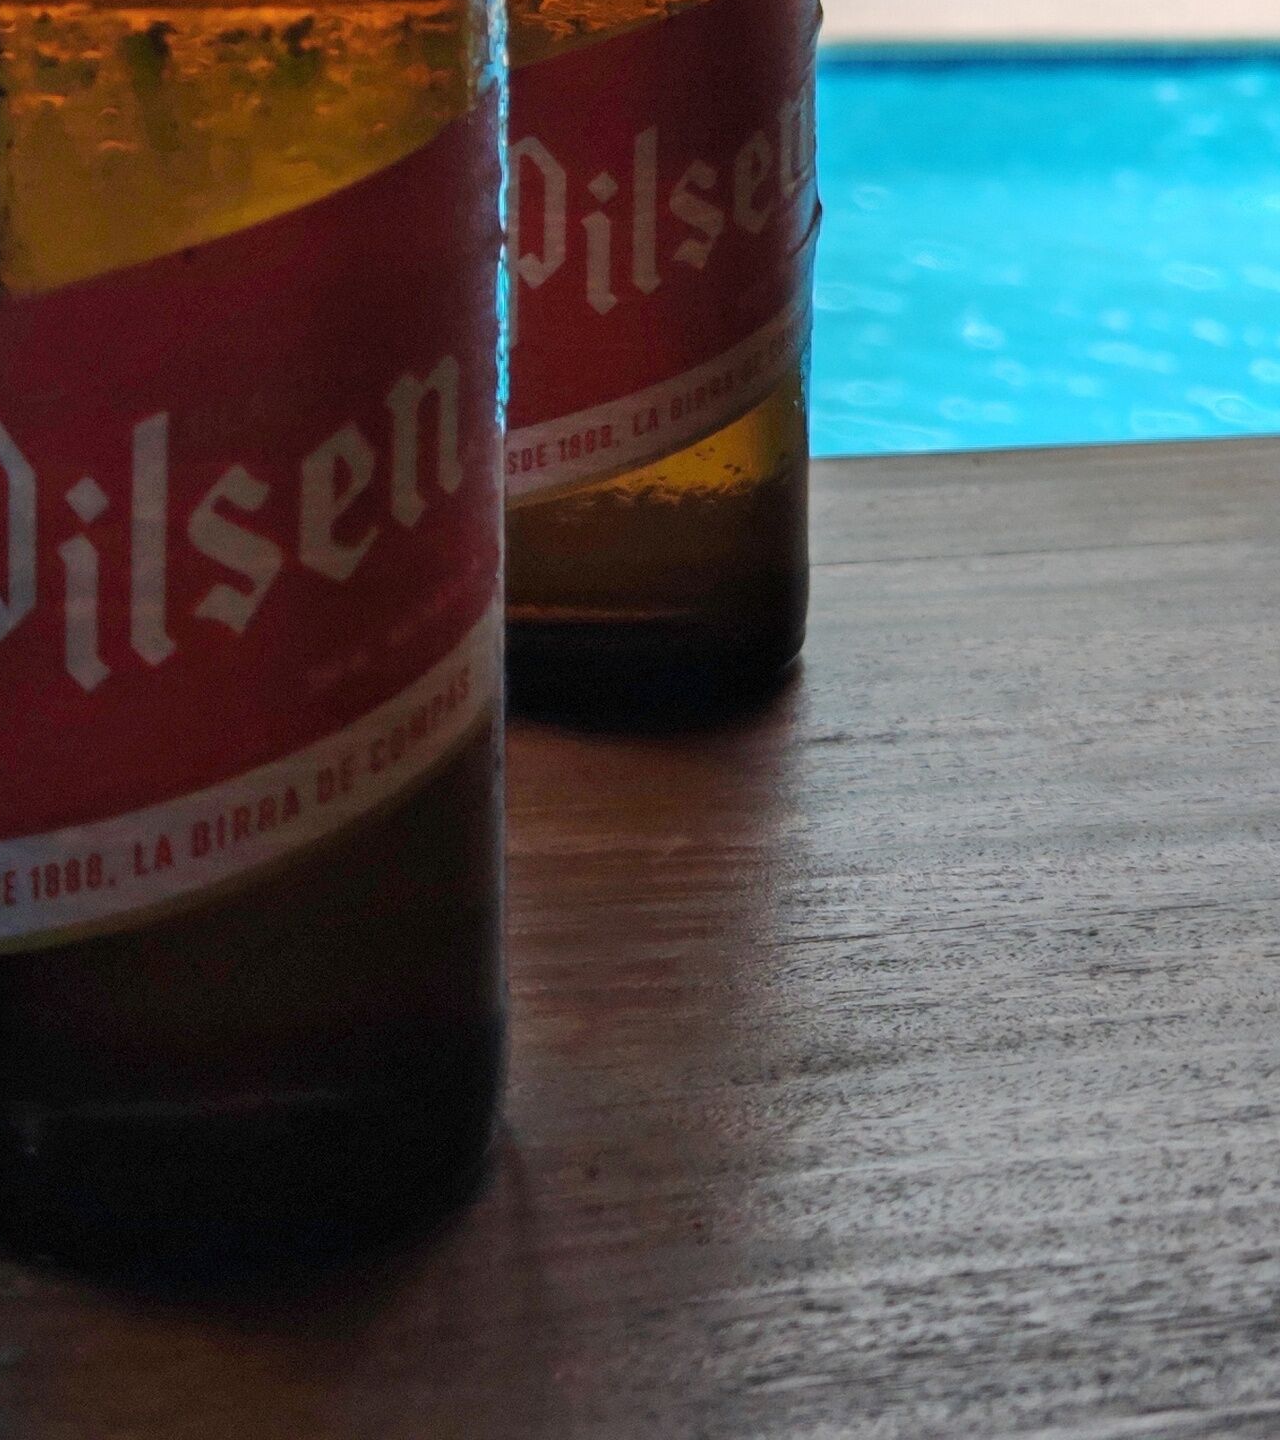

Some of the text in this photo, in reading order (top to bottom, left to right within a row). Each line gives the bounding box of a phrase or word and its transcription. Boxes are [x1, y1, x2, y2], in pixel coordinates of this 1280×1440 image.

[509, 90, 811, 350] Pilsen
[507, 442, 549, 474] SDE
[632, 407, 660, 437] LA
[132, 832, 176, 877] LA
[189, 784, 301, 859] BIRRA
[315, 750, 357, 805] DE
